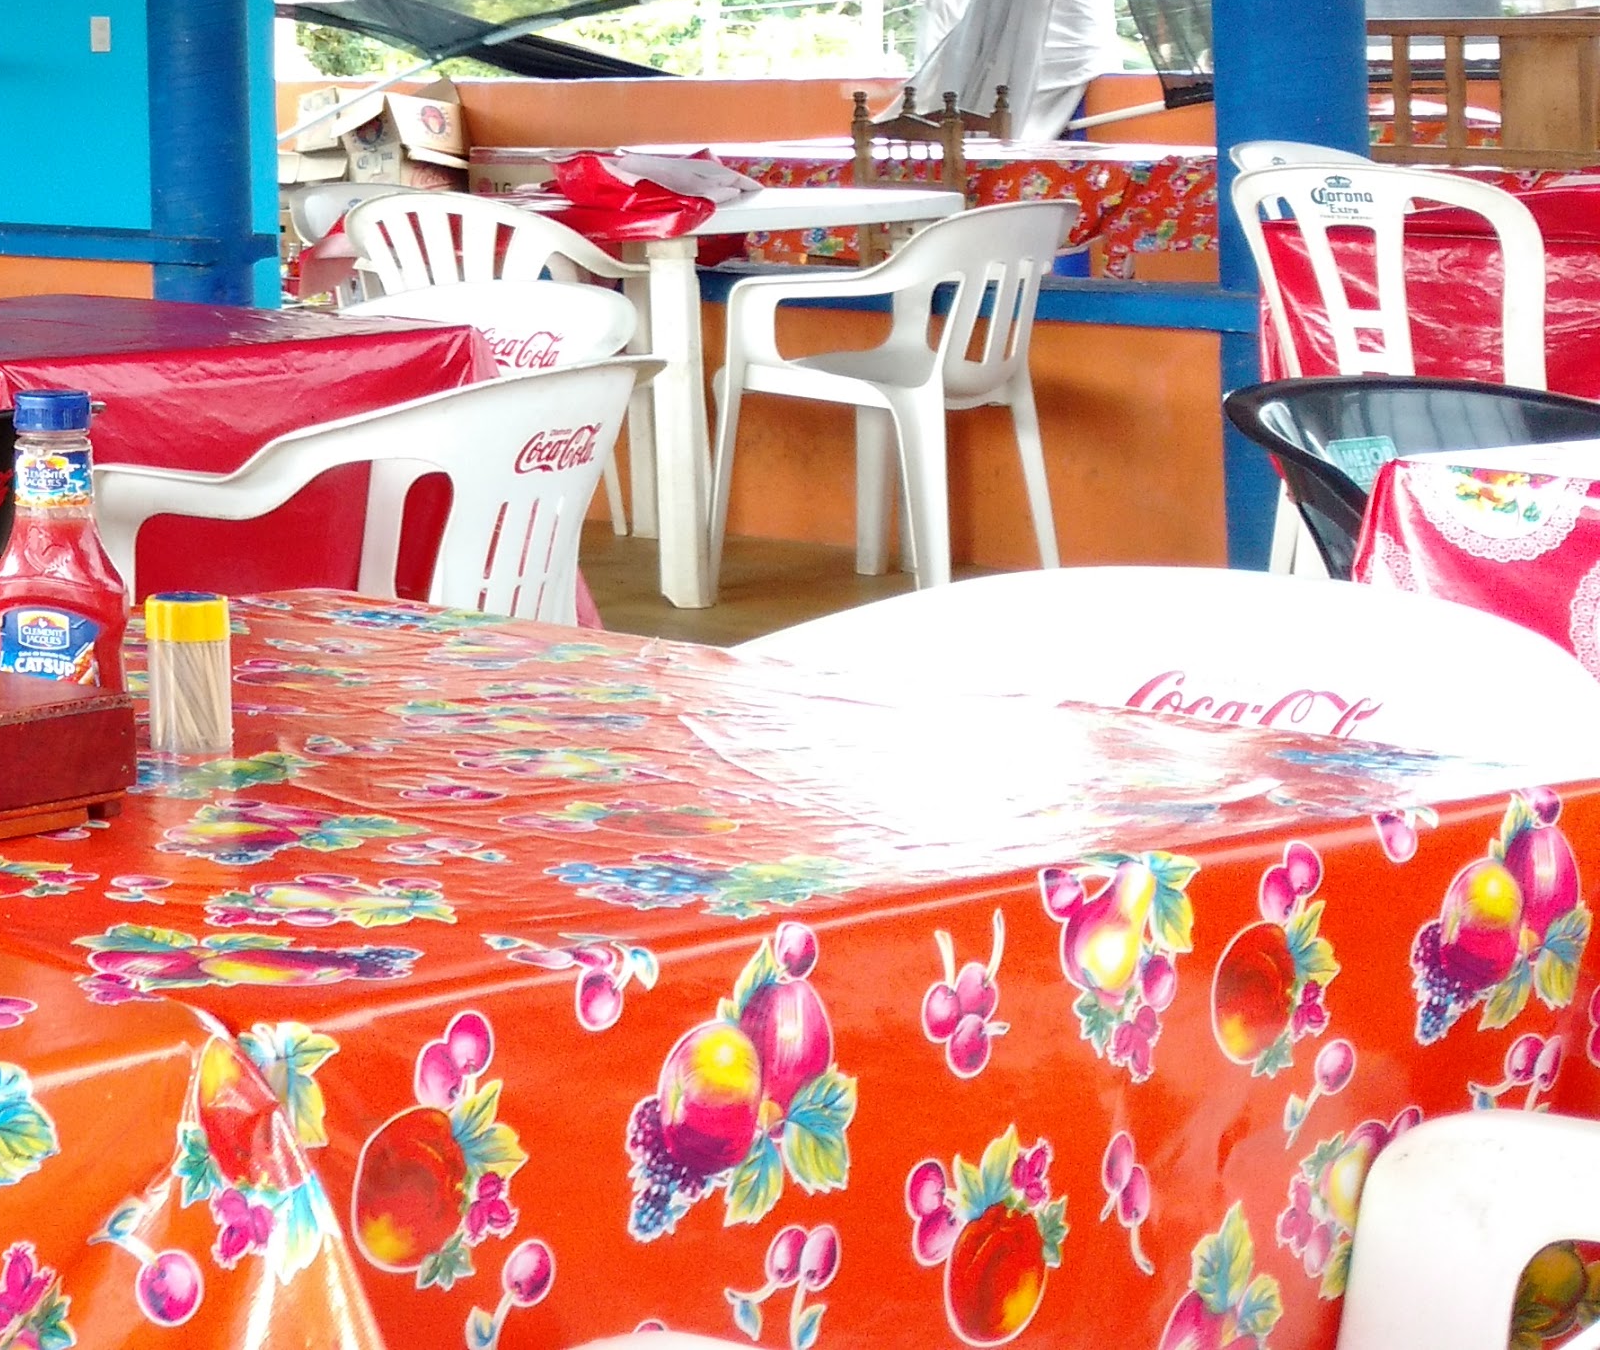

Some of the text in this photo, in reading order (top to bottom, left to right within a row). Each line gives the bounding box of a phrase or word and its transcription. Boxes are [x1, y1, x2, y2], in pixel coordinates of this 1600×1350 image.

[1311, 187, 1373, 206] Corona
[1329, 204, 1359, 213] Extra
[514, 422, 602, 474] Coca-Cola
[14, 656, 75, 677] CATSUP
